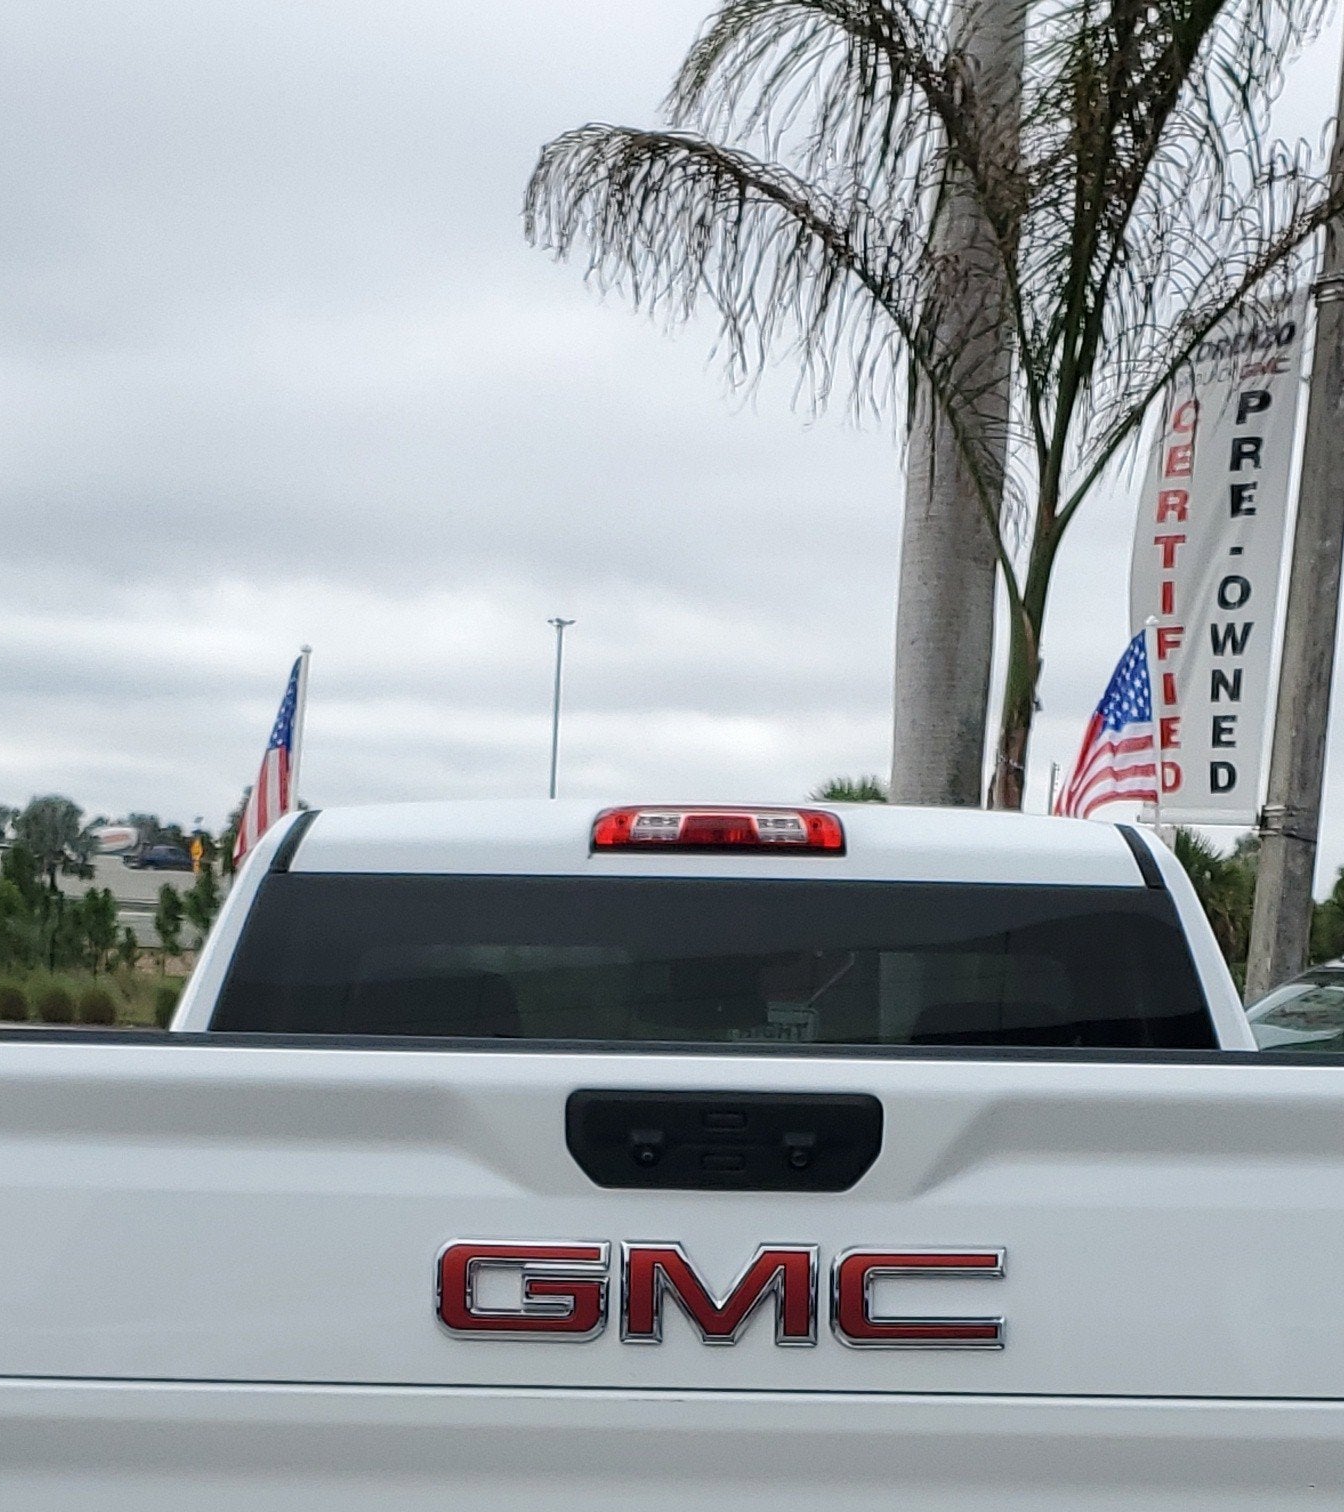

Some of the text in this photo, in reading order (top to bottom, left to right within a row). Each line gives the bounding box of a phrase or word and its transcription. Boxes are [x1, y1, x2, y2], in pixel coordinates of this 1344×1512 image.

[1154, 399, 1200, 794] CERTIFIED
[1210, 389, 1272, 794] PRE-OWNED
[434, 1238, 1007, 1350] GMC
